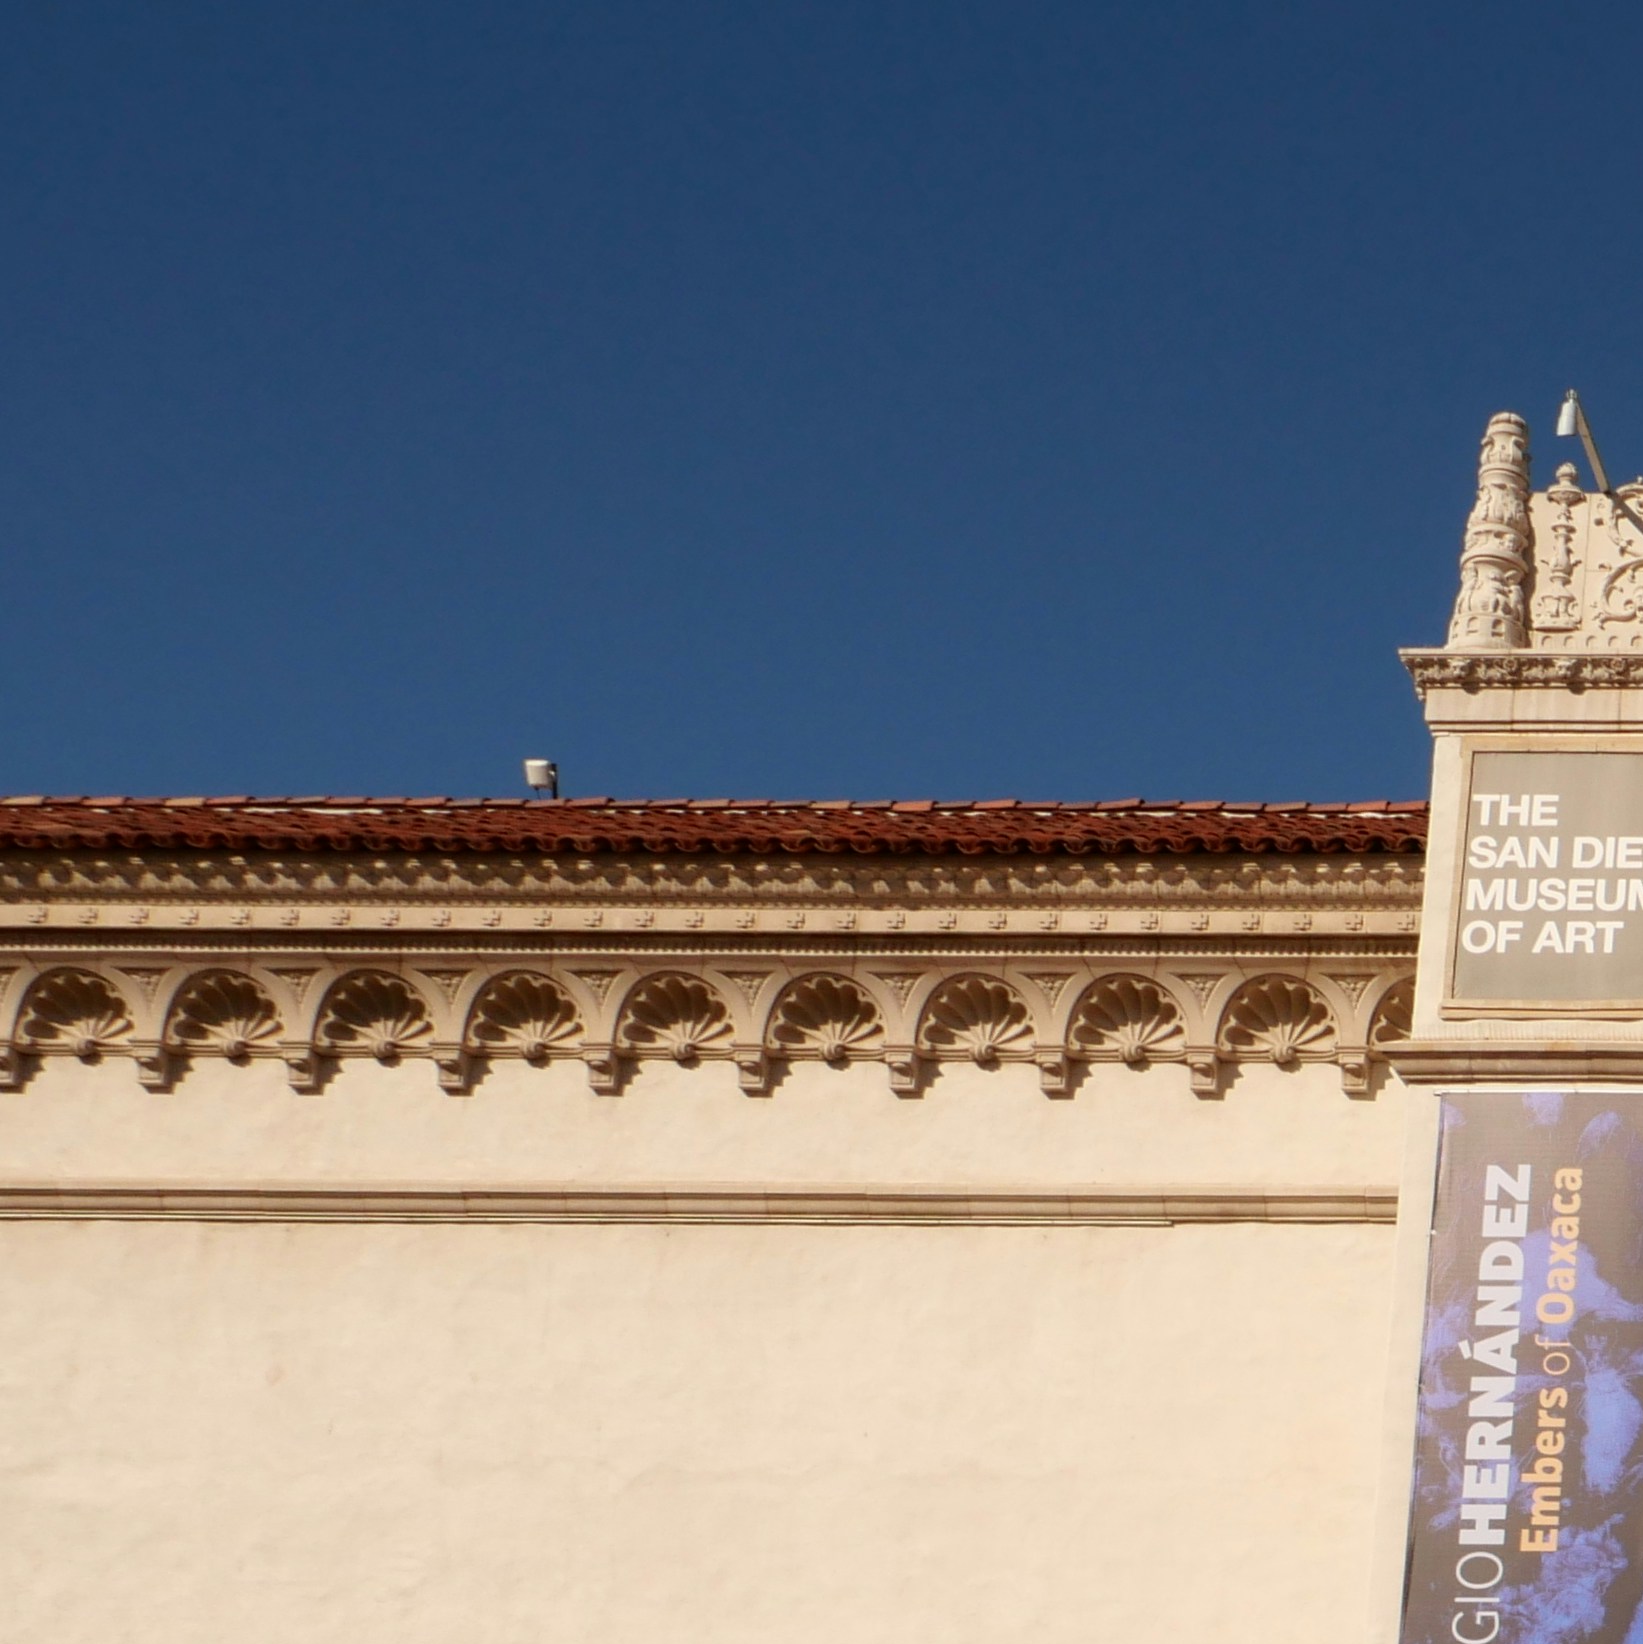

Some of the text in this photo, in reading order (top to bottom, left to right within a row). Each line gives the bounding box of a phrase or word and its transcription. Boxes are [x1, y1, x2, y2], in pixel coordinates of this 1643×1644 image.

[1472, 794, 1559, 827] THE
[1468, 835, 1559, 869] SAN
[1462, 920, 1625, 954] OF ART
[1520, 1167, 1583, 1552] Embers of Oaxaca
